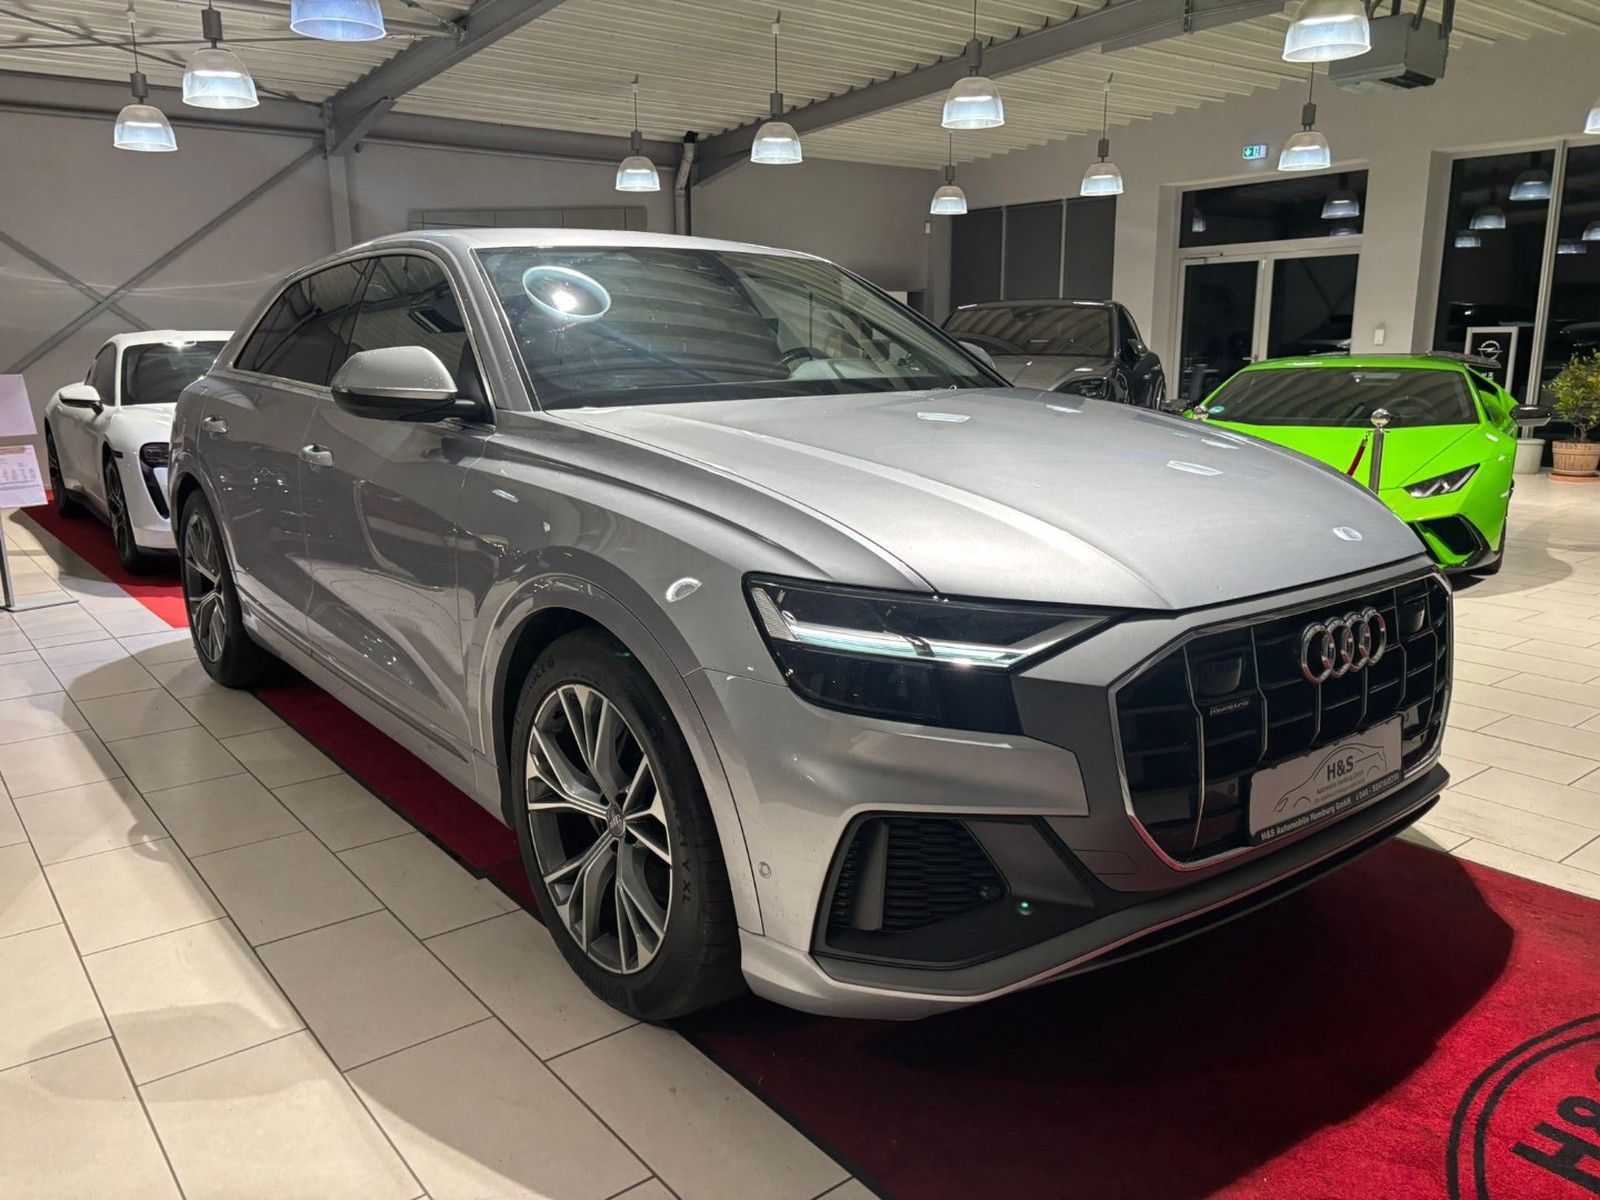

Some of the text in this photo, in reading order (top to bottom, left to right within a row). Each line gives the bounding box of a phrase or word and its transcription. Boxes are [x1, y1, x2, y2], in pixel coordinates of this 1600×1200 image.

[1327, 755, 1354, 781] H&S
[1261, 829, 1275, 841] H&S
[1276, 815, 1309, 835] Automobile
[1310, 805, 1335, 821] Hamburg
[1509, 1064, 1600, 1196] H&
